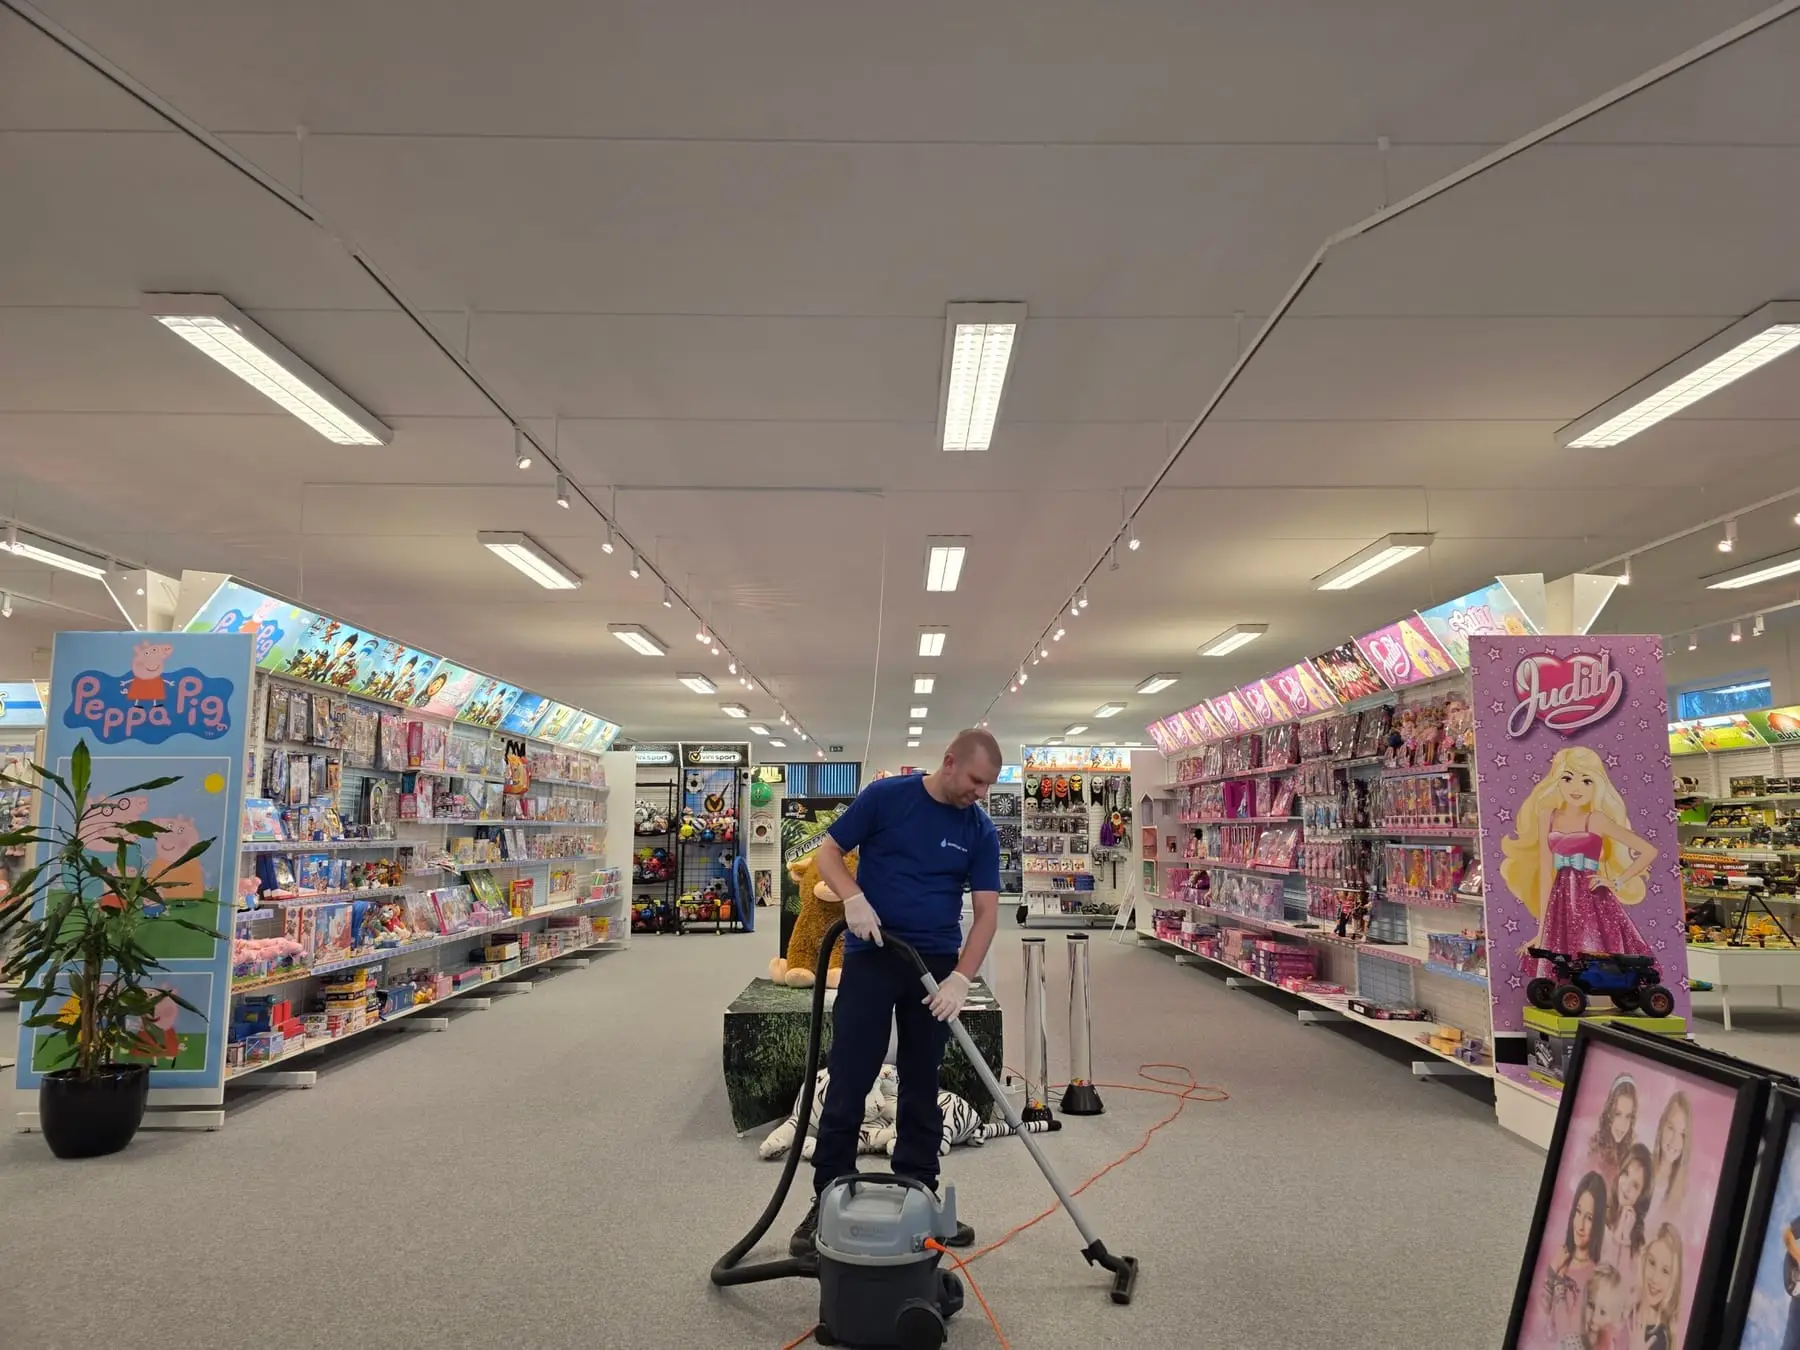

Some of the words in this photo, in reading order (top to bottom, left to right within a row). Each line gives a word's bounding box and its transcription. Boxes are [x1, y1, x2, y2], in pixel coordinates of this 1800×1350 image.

[74, 676, 172, 739] Peppa
[177, 676, 228, 733] Pig
[1506, 652, 1623, 738] Judith
